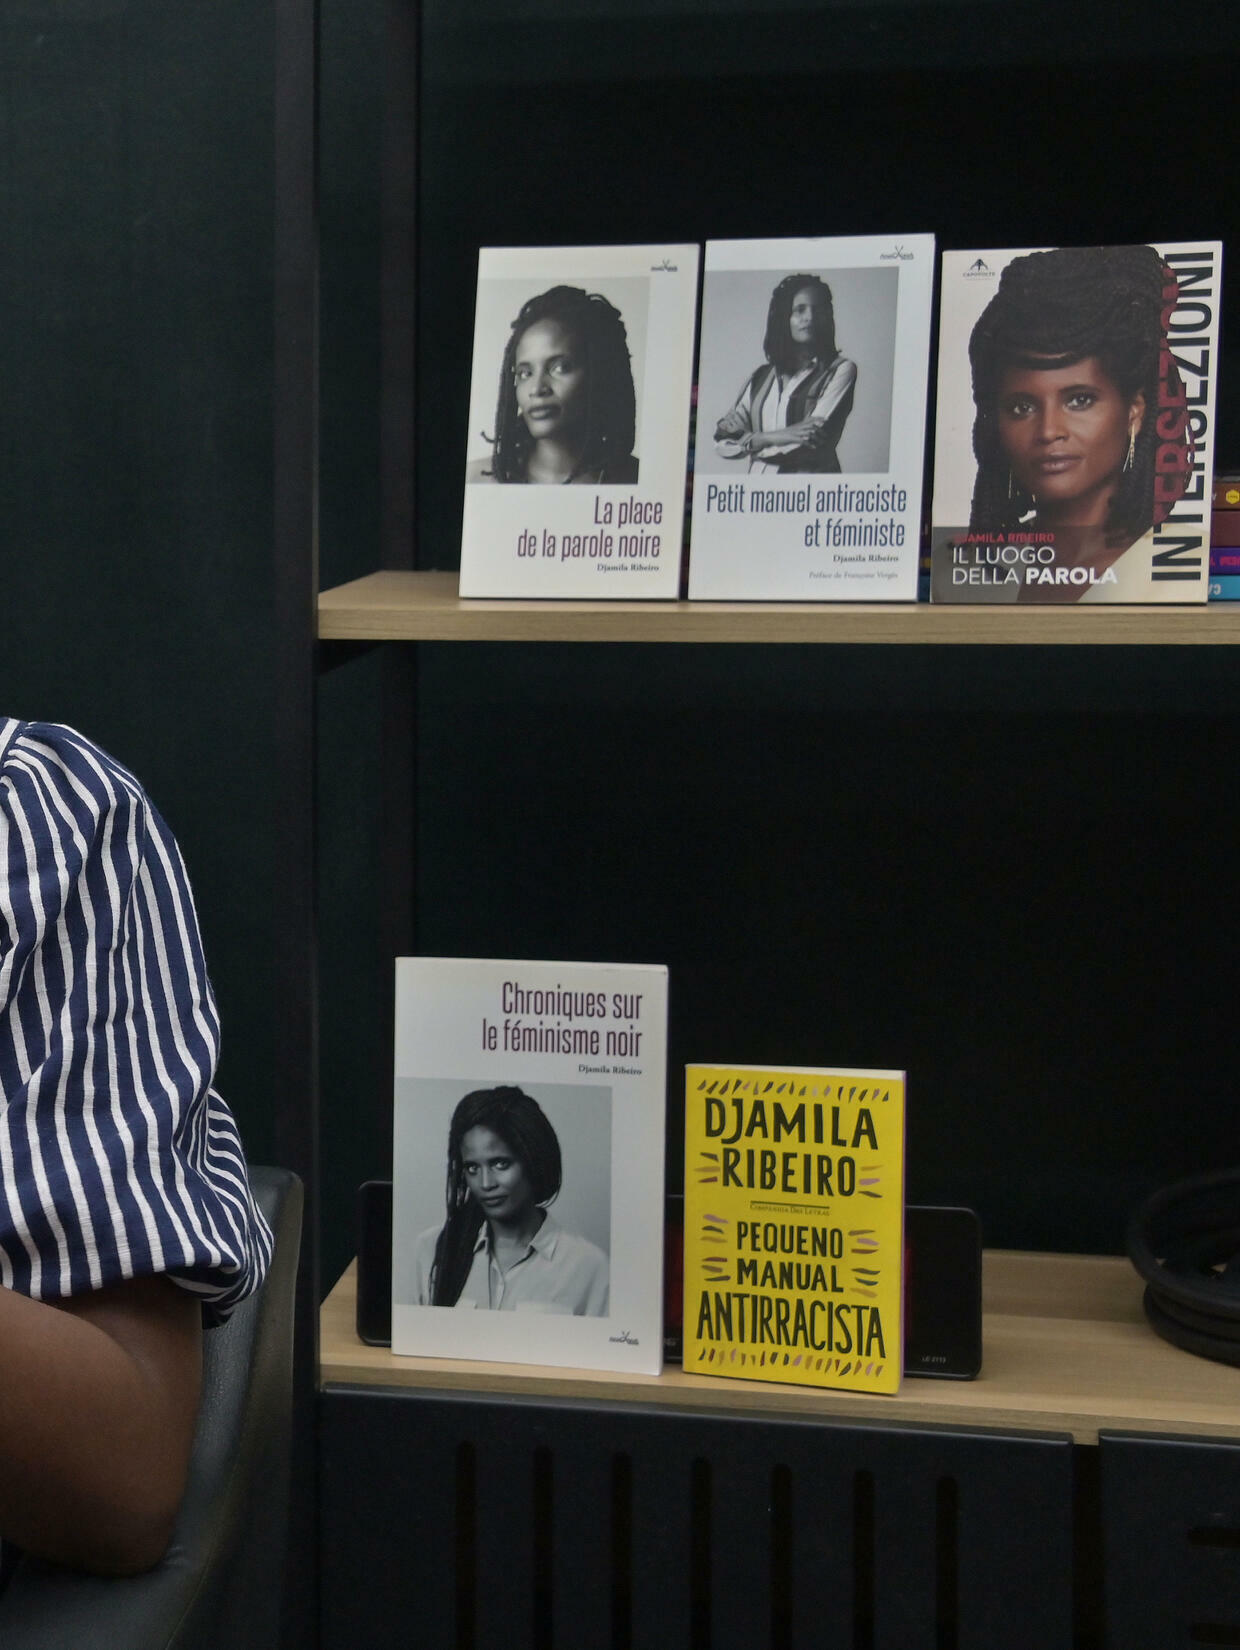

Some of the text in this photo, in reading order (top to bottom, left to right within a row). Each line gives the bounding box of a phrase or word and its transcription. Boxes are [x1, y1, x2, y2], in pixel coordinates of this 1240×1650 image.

[594, 495, 663, 529] La place
[706, 483, 907, 514] Petit manuel antiraciste
[517, 528, 661, 562] de la parole noire
[804, 518, 905, 547] et féministe
[1007, 532, 1055, 543] RIBEIRO
[597, 563, 659, 573] Djamila Ribeiro
[833, 554, 899, 563] Djamila Ribeiro
[952, 546, 1055, 565] IL LUOGO
[952, 567, 1118, 585] DELLA PAROLA
[502, 981, 643, 1021] Chroniques sur
[482, 1018, 643, 1056] le féminisme noir
[578, 1064, 642, 1075] Djamila Ribeiro
[705, 1097, 878, 1150] DJAMILA
[722, 1147, 856, 1197] RIBEIRO
[736, 1221, 843, 1259] PEQUENO
[736, 1258, 844, 1293] MANUAL
[696, 1290, 886, 1359] ANTIRRACISTA
